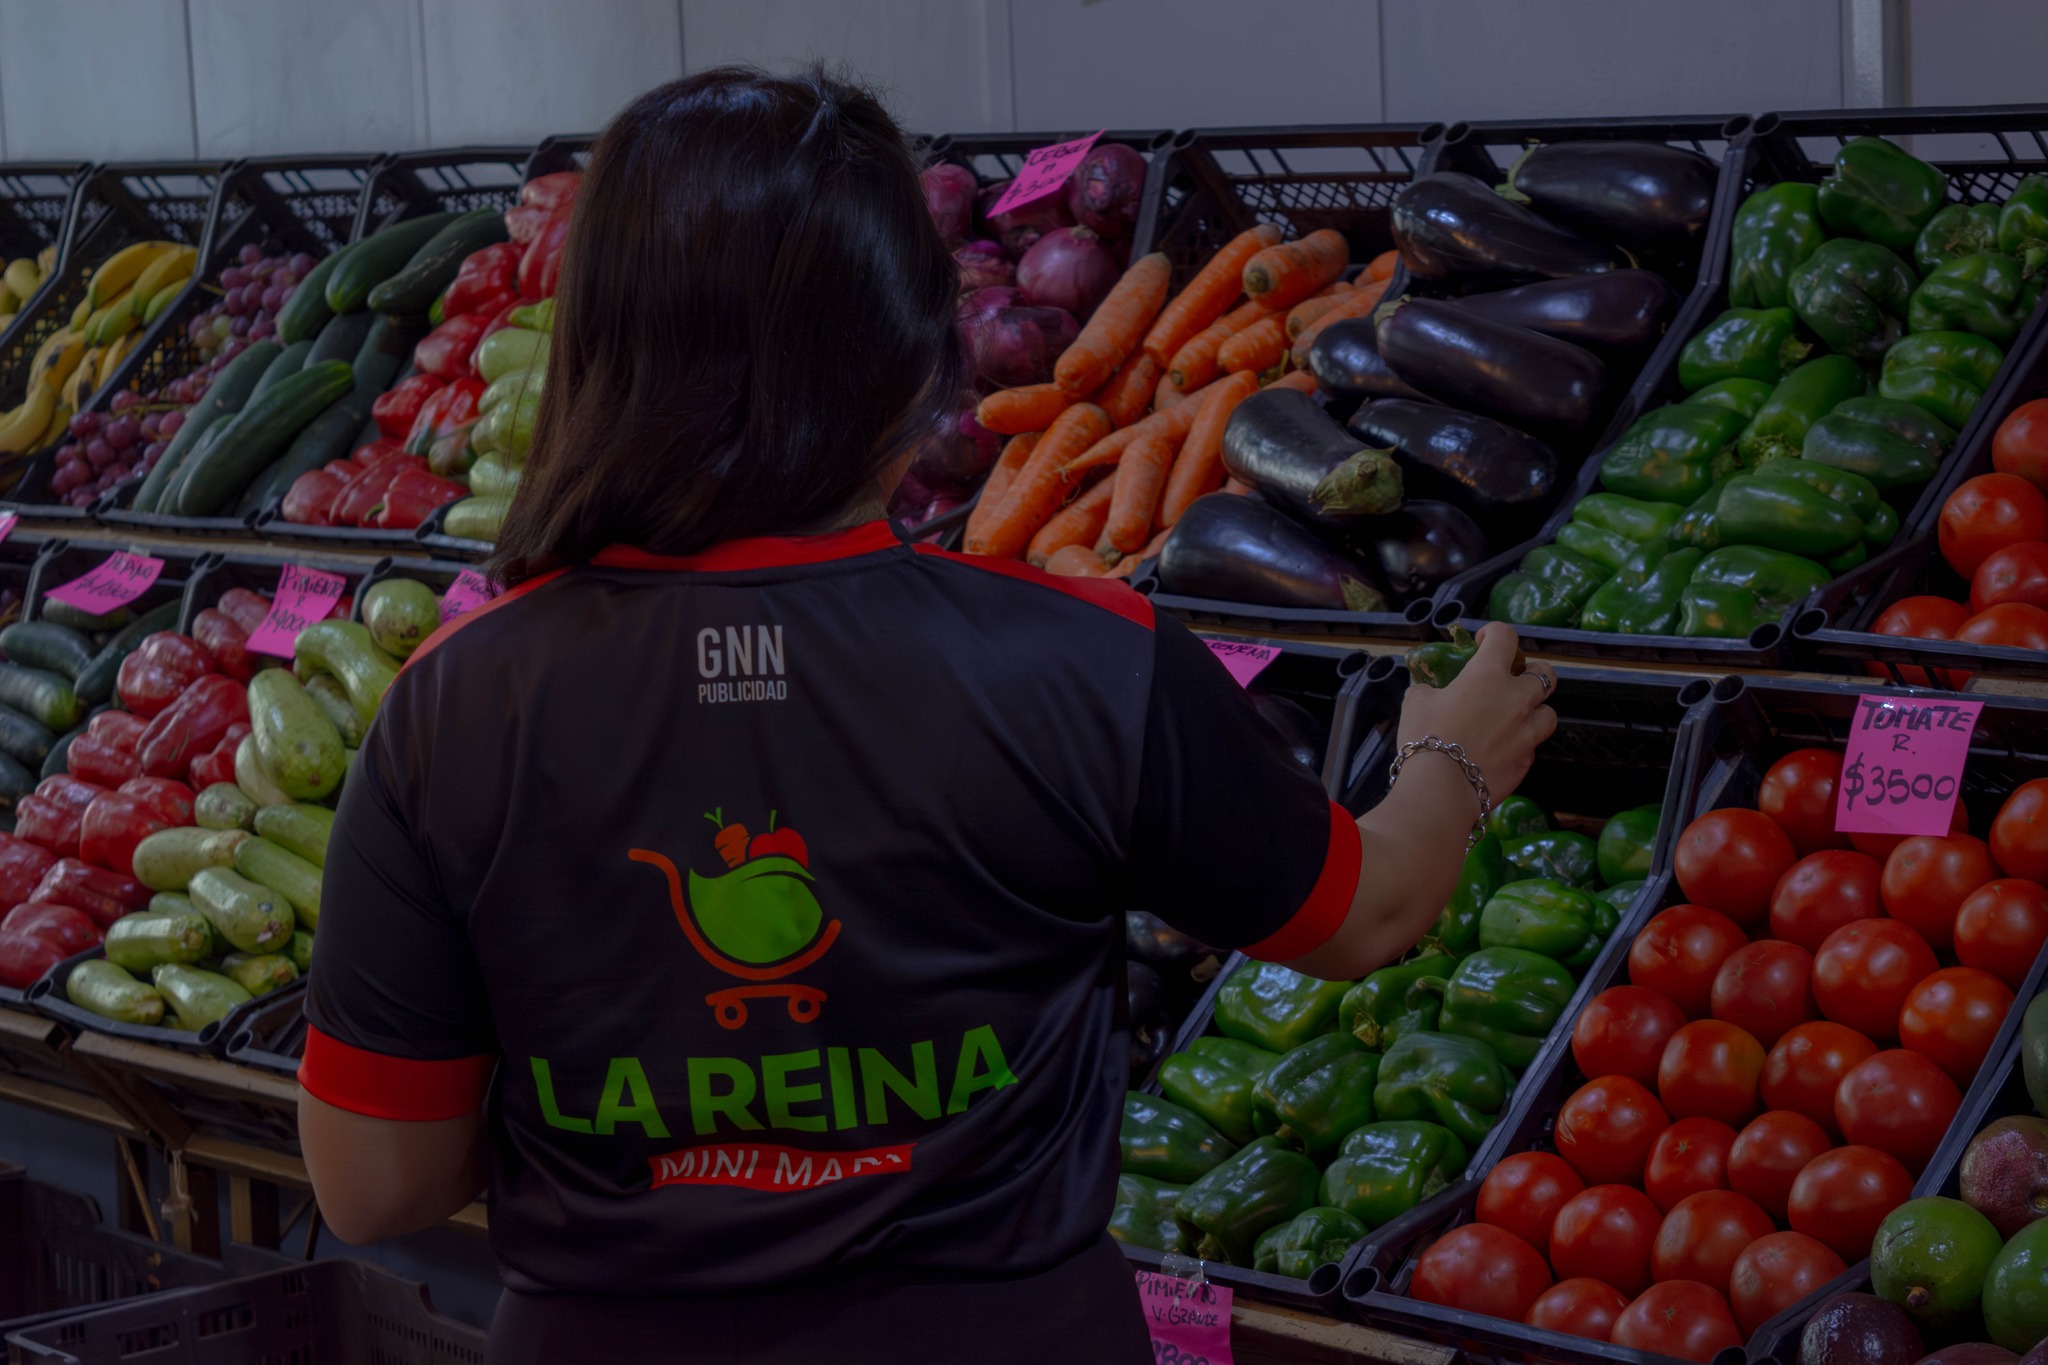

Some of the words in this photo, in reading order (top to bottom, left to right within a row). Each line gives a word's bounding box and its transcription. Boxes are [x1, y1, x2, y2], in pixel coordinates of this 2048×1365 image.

[697, 625, 785, 679] GNN
[698, 680, 788, 704] PUBLICIDAD
[1861, 699, 1974, 732] TOMATE
[1844, 751, 1956, 812] $3500
[529, 1056, 671, 1139] LA
[686, 1023, 1019, 1137] REINA
[660, 1149, 760, 1182] MINI
[773, 1151, 902, 1187] MA
